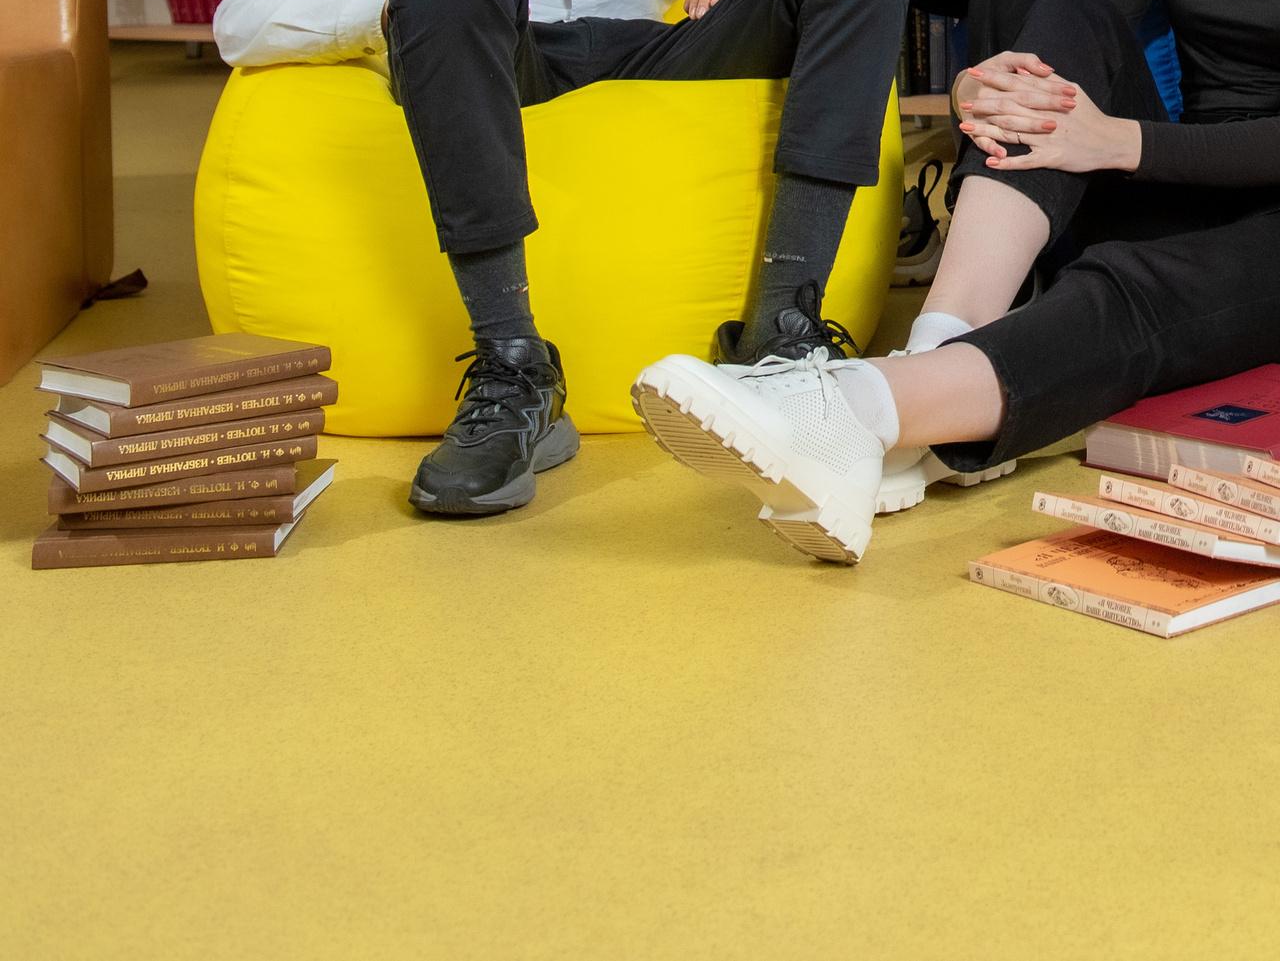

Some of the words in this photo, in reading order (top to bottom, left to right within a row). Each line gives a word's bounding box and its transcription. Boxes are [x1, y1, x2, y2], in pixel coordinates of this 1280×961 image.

[778, 253, 807, 263] ASSN.
[246, 363, 280, 377] ТЮТЧЕВ
[189, 371, 240, 388] ИЗБРАННАЯ
[152, 380, 188, 395] ЛИРИКА
[241, 396, 280, 410] ТЮТЧЕВ
[282, 394, 293, 405] И.
[294, 392, 306, 402] Ф.
[135, 411, 175, 425] ЛИРИКА
[176, 403, 234, 420] ИЗБРАННАЯ
[226, 426, 266, 439] ТЮТЧЕВ
[268, 424, 279, 434] И.
[281, 422, 293, 432] Ф.
[118, 440, 158, 455] ЛИРИКА
[160, 432, 219, 449] ИЗБРАННАЯ
[216, 451, 257, 465] ТЮТЧЕВ
[260, 449, 270, 459] И.
[273, 448, 284, 456] Ф.
[106, 466, 147, 481] ЛИРИКА
[149, 458, 208, 475] ИЗБРАННАЯ
[119, 486, 180, 500] ИЗБРАННАЯ
[189, 481, 230, 494] ТЮТЧЕВ
[75, 492, 117, 503] ЛИРИКА
[1203, 514, 1218, 526] ВАШЕ
[1137, 528, 1153, 540] ВАШЕ
[1153, 531, 1190, 549] СИЯТЕЛЬСТВО»
[1085, 604, 1102, 617] ВАШЕ
[1101, 608, 1142, 628] СИЯТЕЛЬСТВО»
